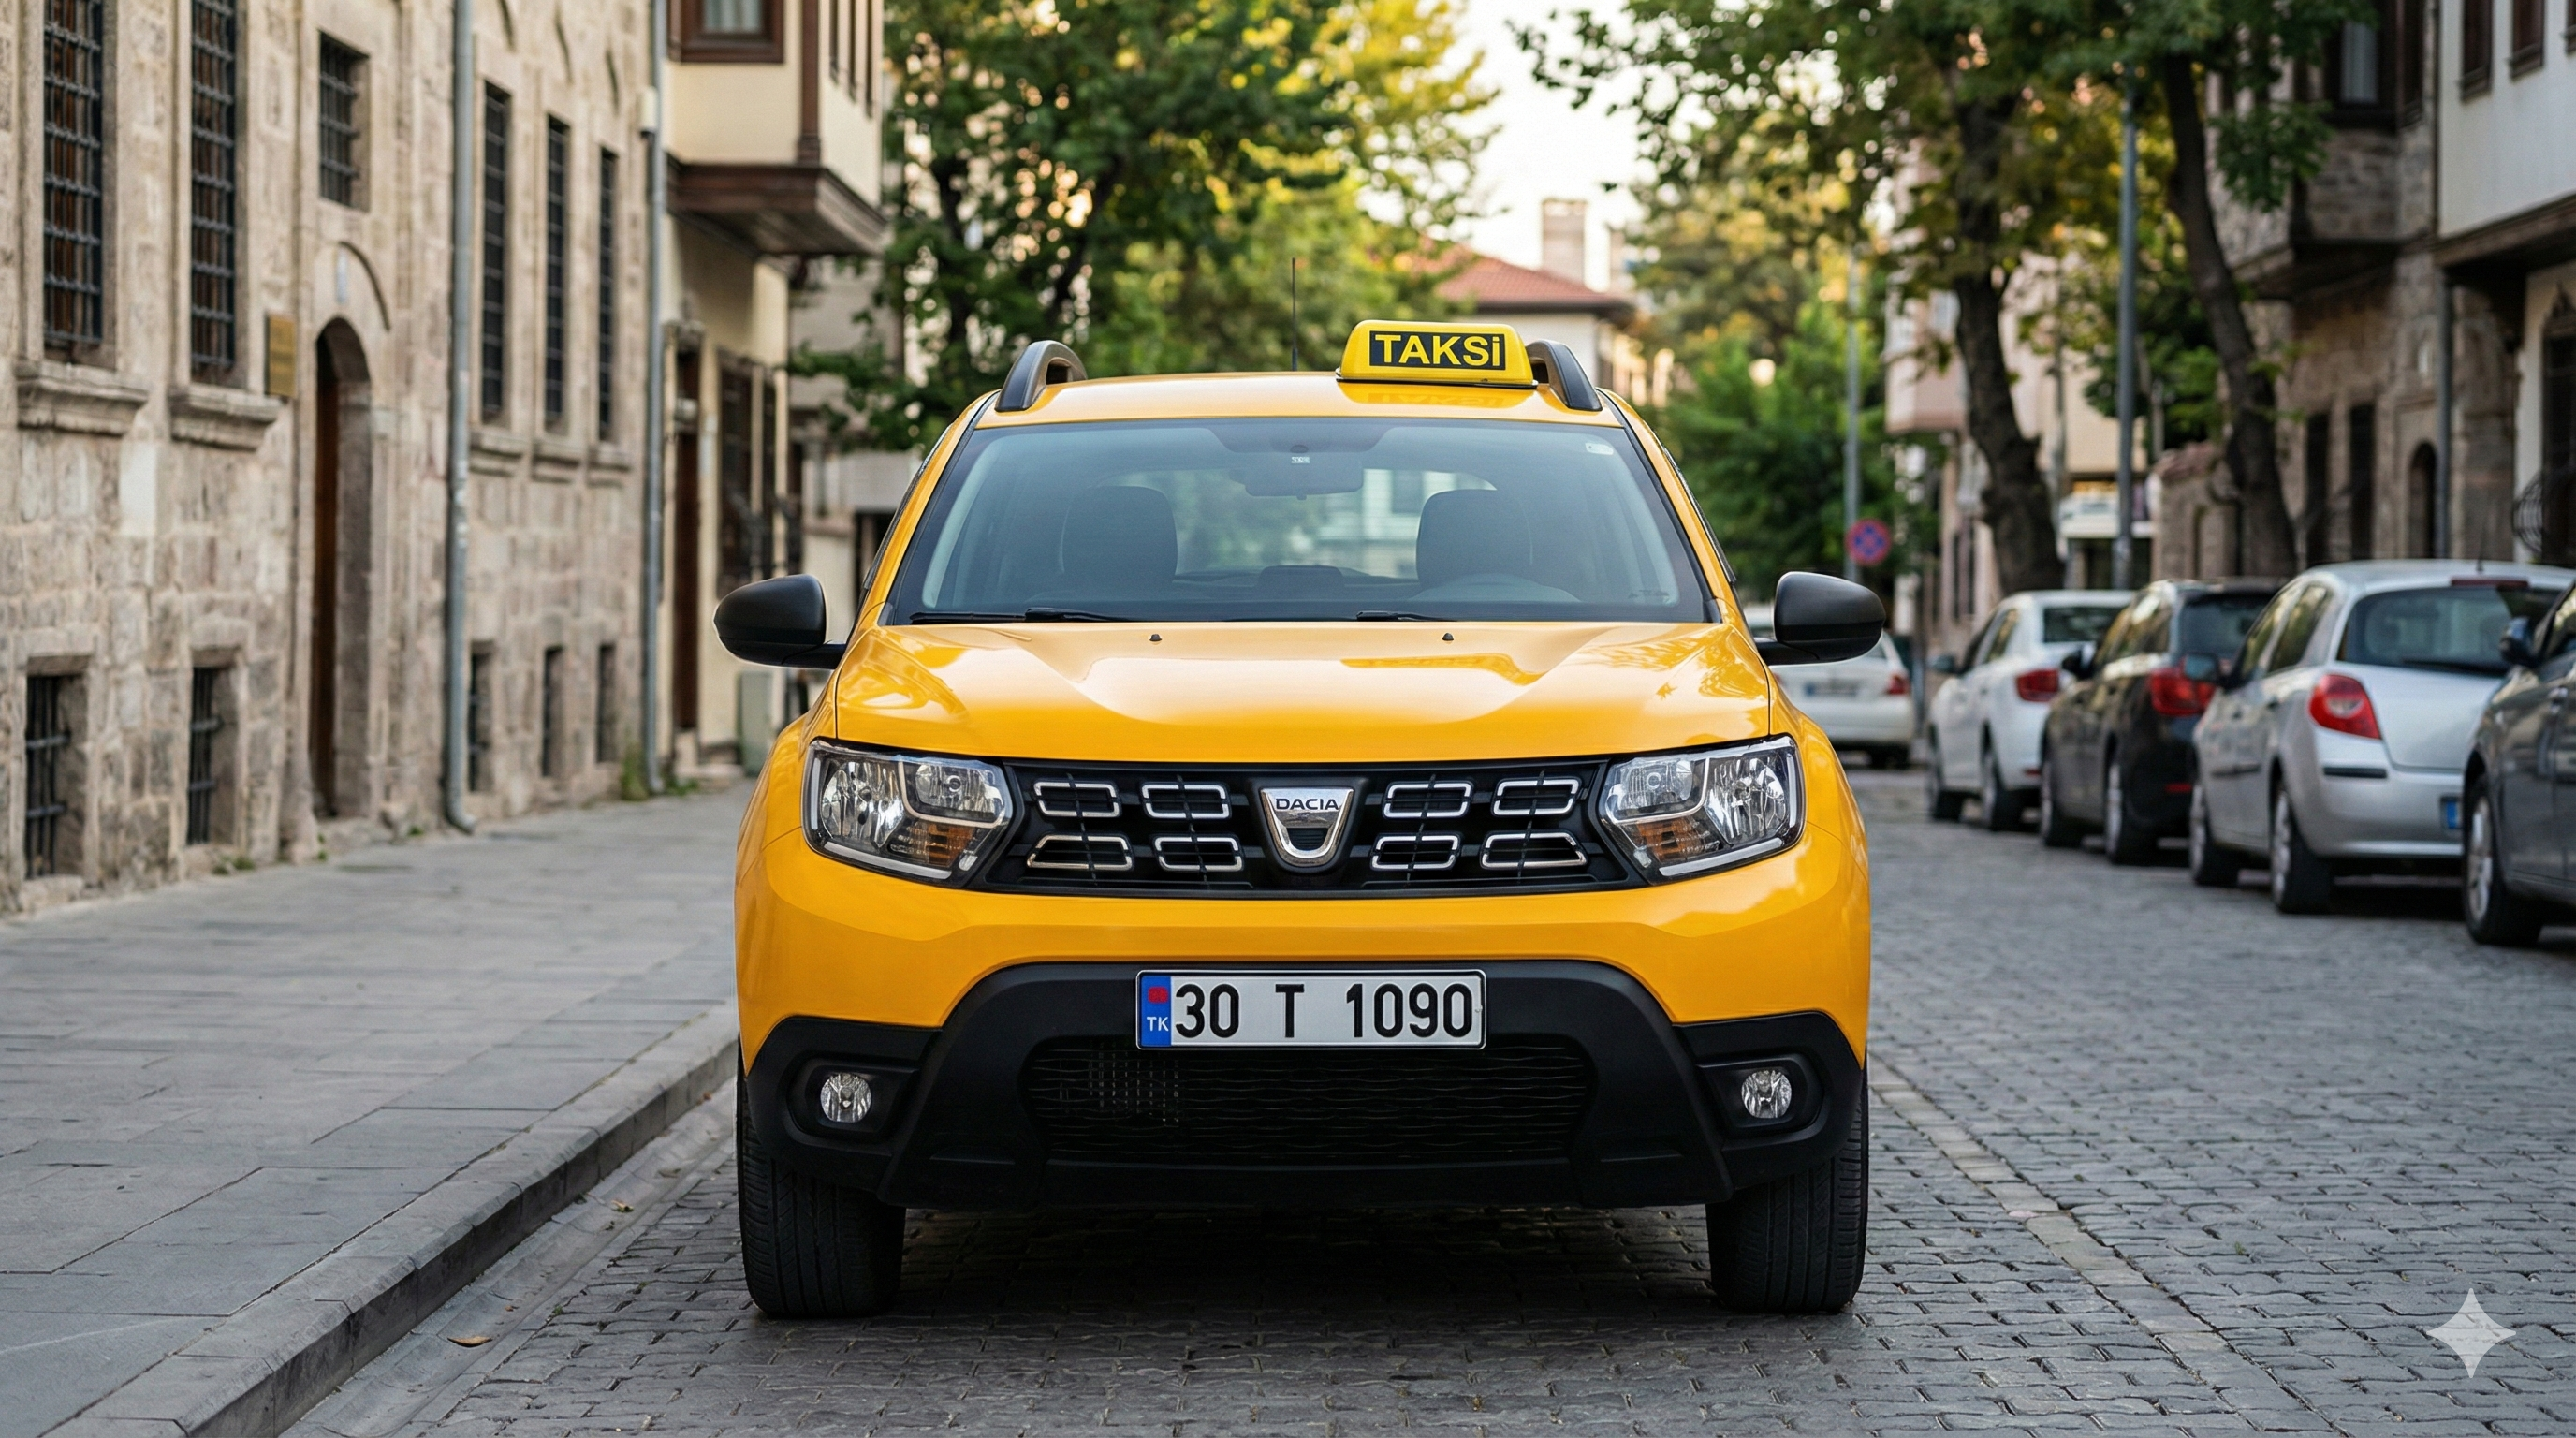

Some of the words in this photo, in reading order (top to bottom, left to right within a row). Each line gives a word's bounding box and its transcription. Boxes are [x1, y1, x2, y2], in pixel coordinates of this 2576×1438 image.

[1276, 798, 1339, 810] DACIA
[1175, 983, 1240, 1038] 30
[1275, 983, 1305, 1038] T
[1346, 983, 1473, 1038] 1090
[1146, 1016, 1169, 1032] TK
